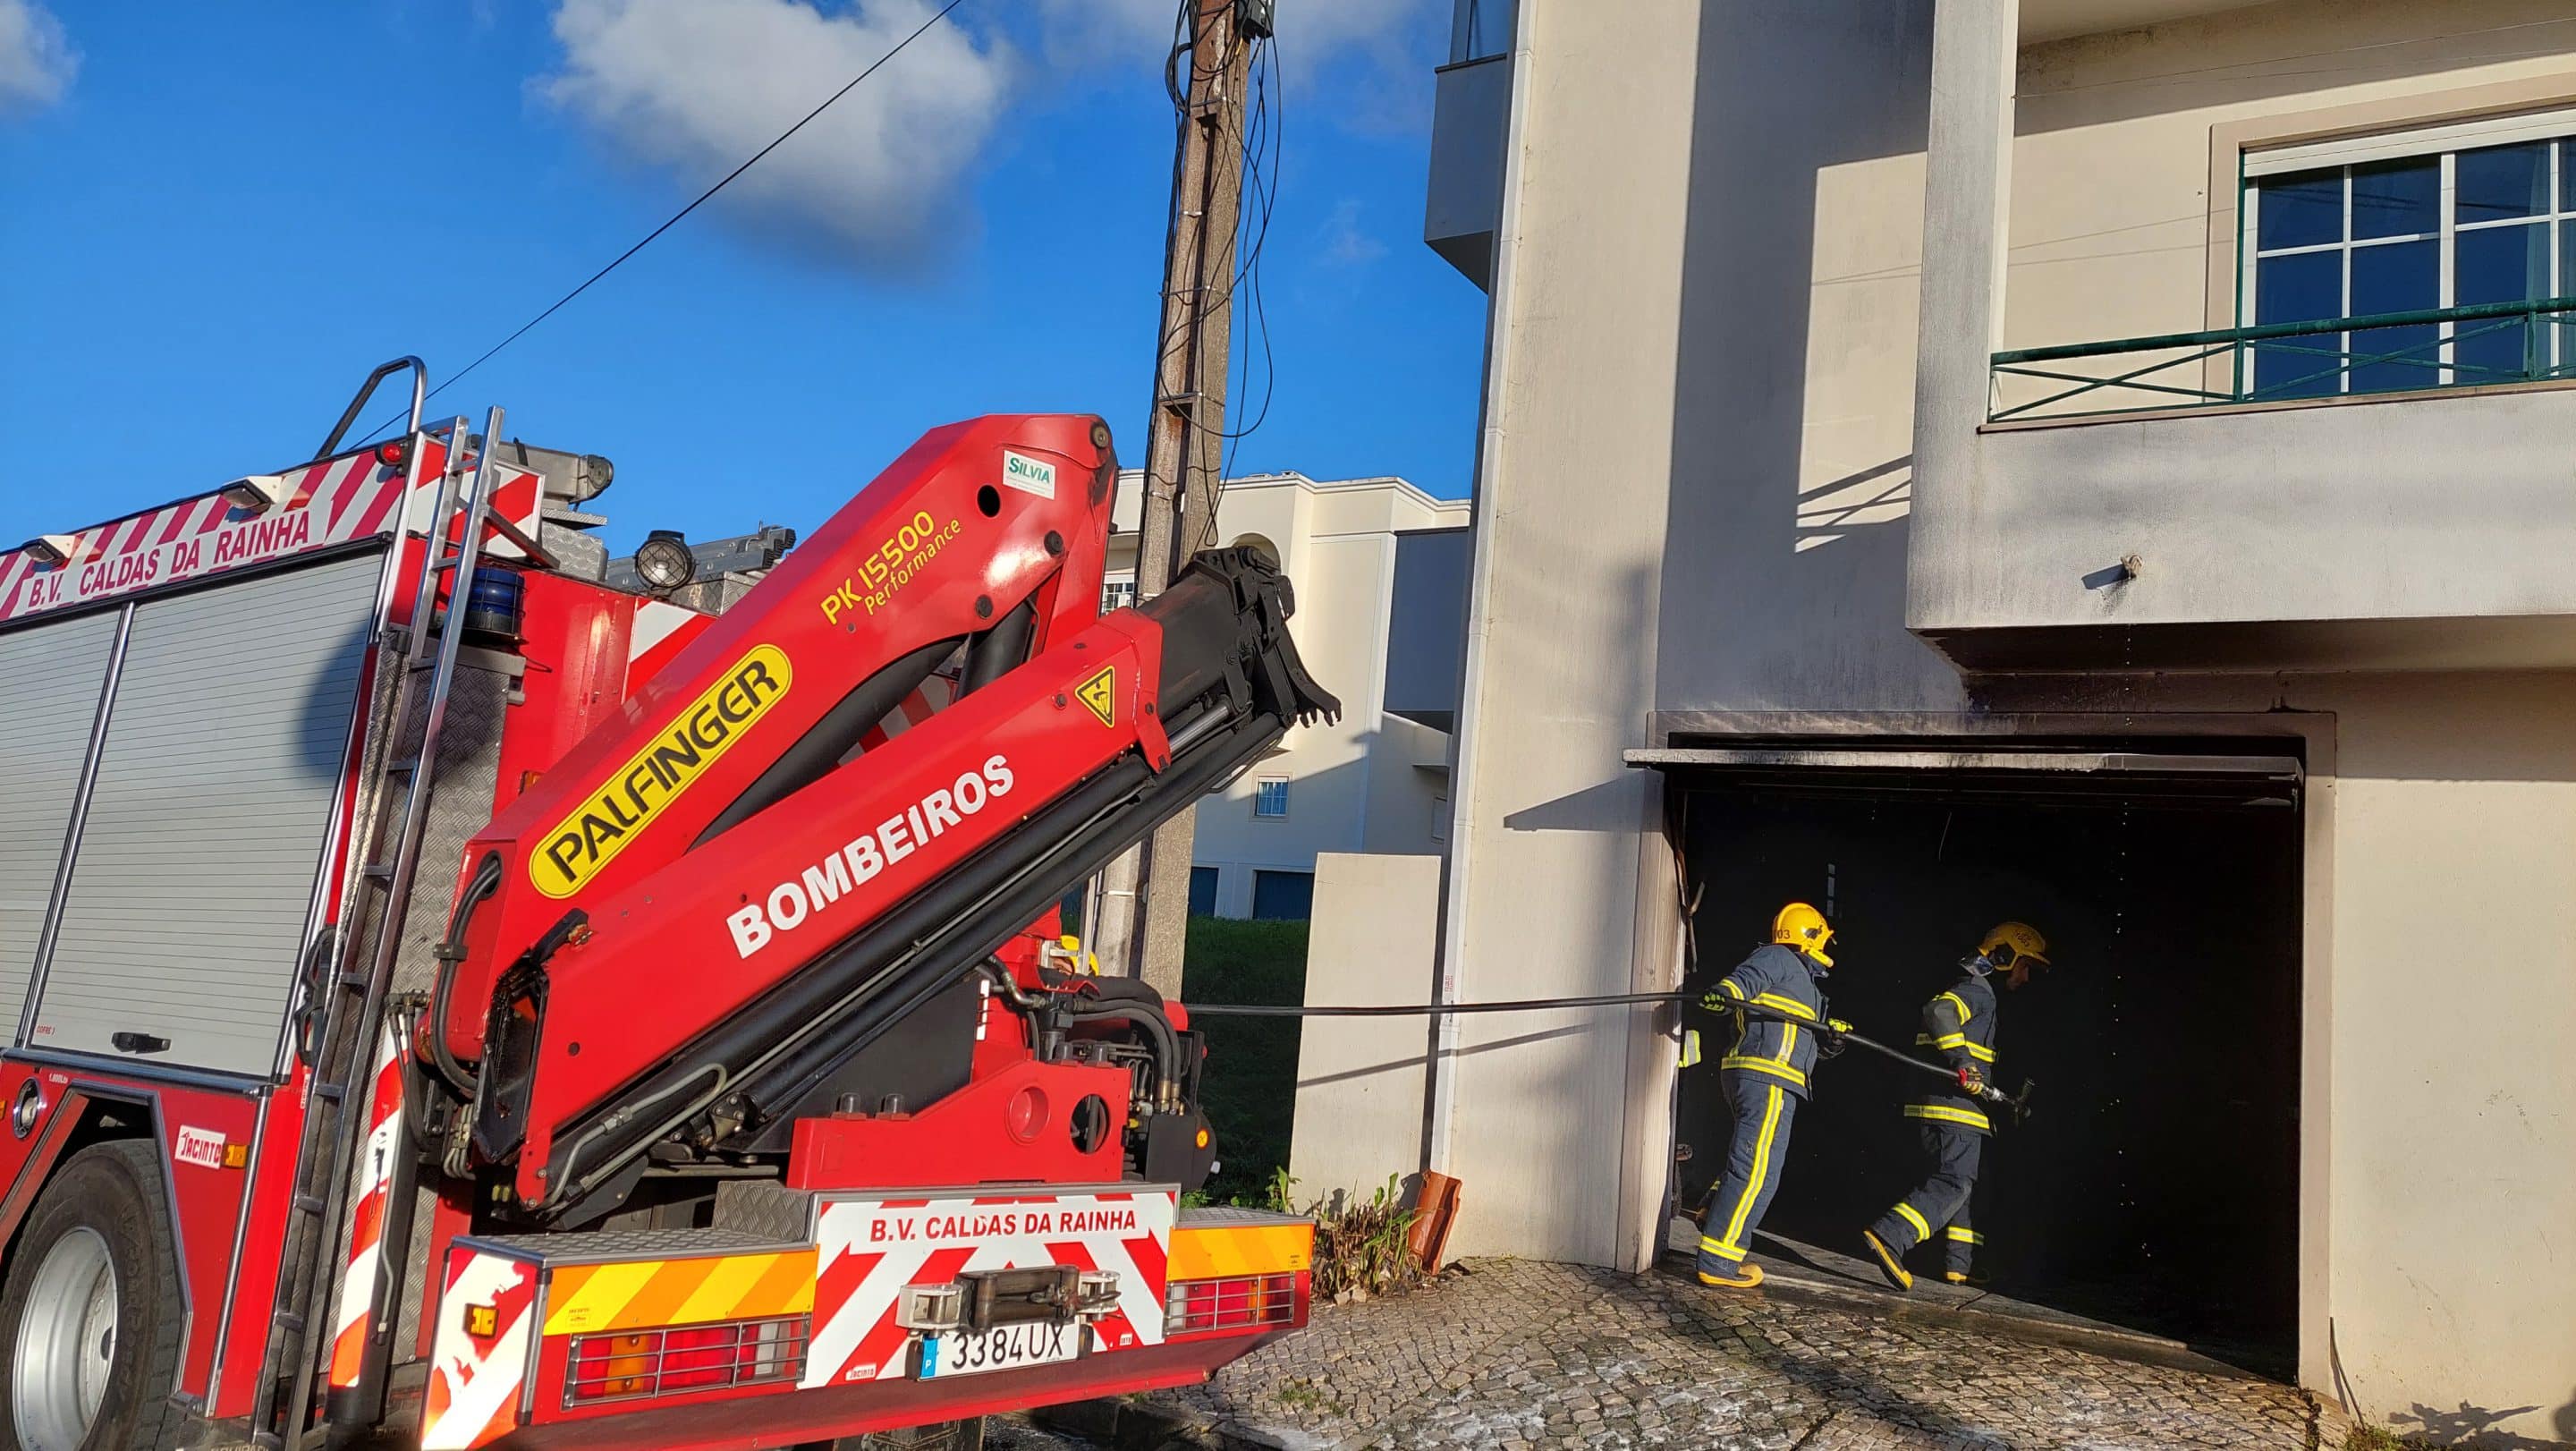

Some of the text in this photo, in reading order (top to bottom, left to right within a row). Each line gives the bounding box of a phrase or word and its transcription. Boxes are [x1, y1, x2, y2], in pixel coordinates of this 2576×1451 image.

[1008, 457, 1050, 484] SILVIA
[28, 511, 309, 607] B.V. CALDAS DA RAINHA
[820, 511, 935, 625] PK 15500
[863, 518, 962, 616] Performance
[546, 660, 780, 884] PALFINGER
[725, 754, 1014, 960] BOMBEIROS
[870, 1209, 1136, 1243] B.V. CALDAS DA RAINHA
